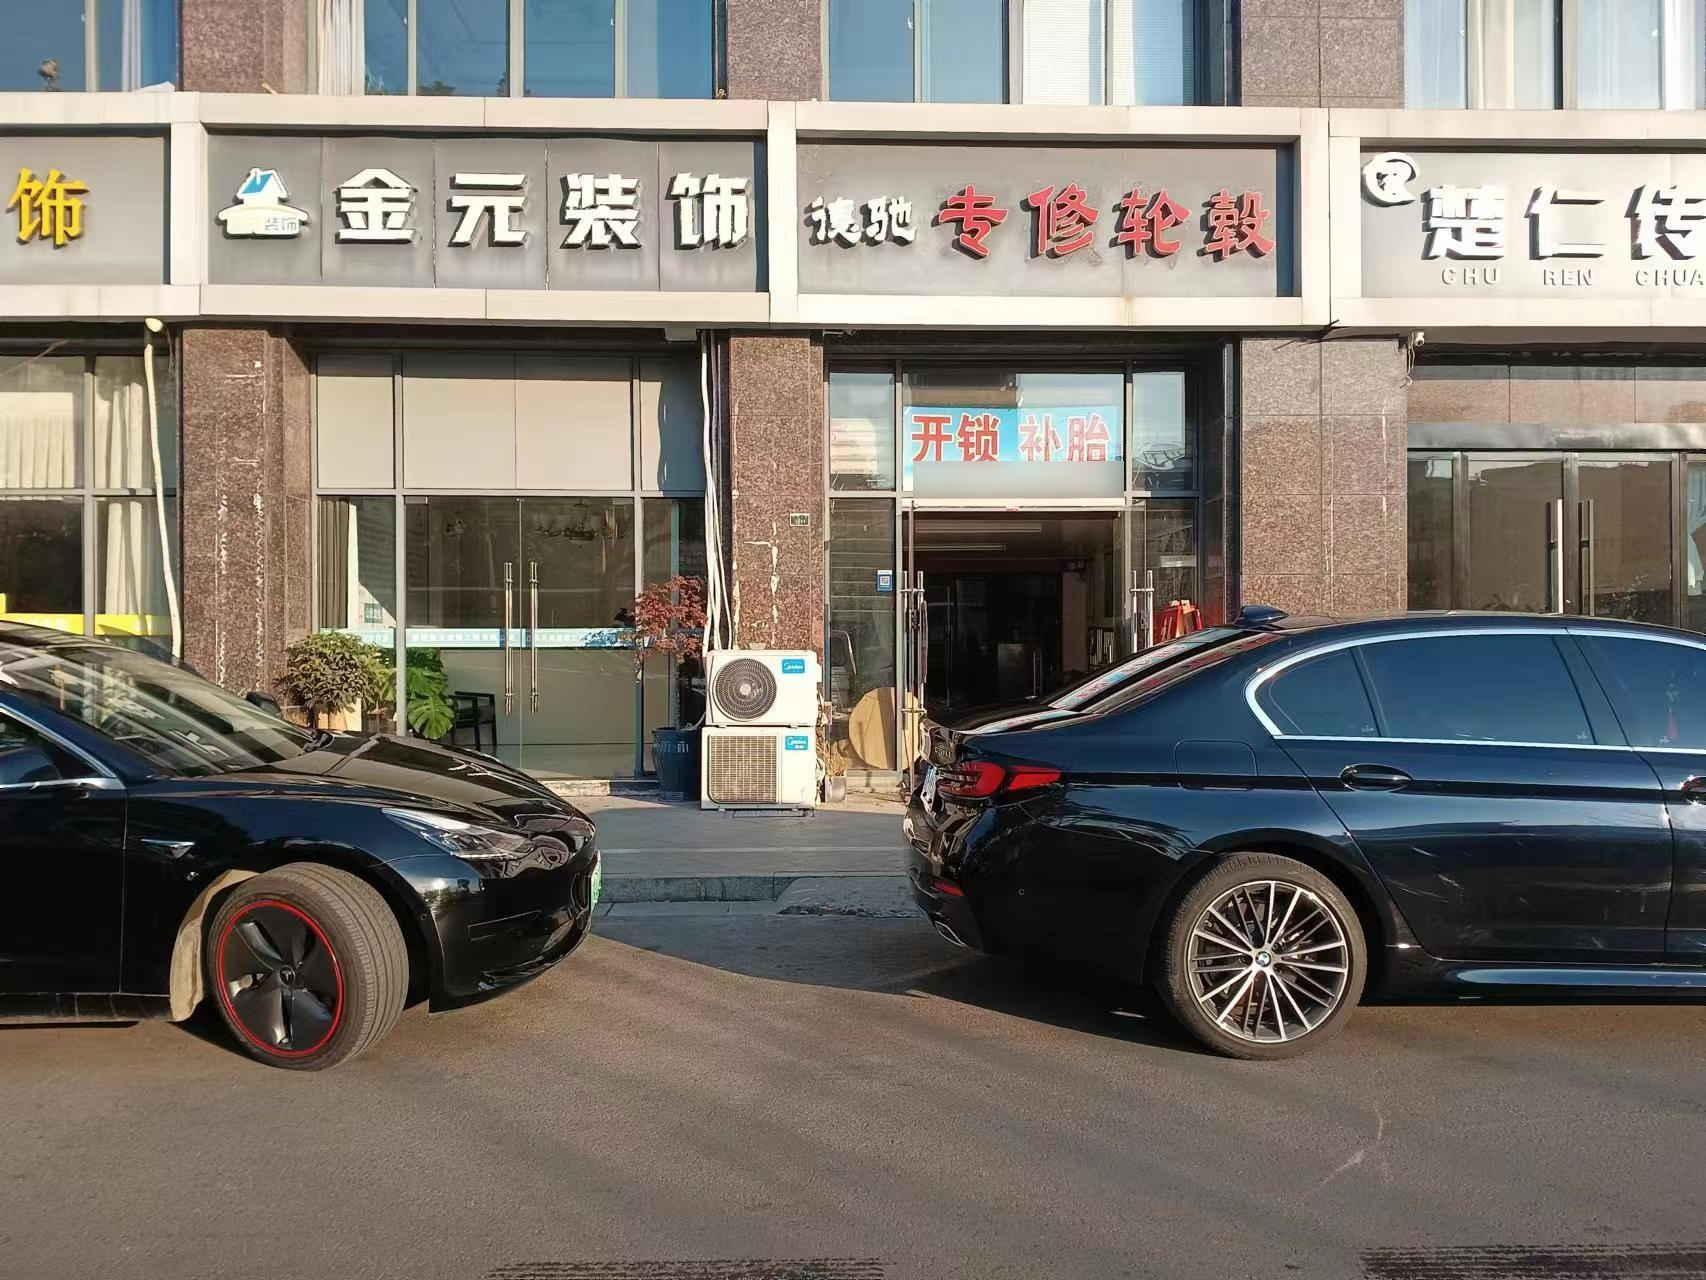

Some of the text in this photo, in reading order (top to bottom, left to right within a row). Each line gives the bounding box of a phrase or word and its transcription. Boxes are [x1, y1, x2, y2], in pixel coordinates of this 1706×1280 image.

[8, 167, 86, 246] 饰
[337, 168, 753, 247] 金元装饰
[938, 184, 1276, 257] 专修轮毂
[1440, 267, 1500, 286] CHU
[1543, 268, 1594, 286] REN
[911, 414, 1110, 462] 开锁 补胎
